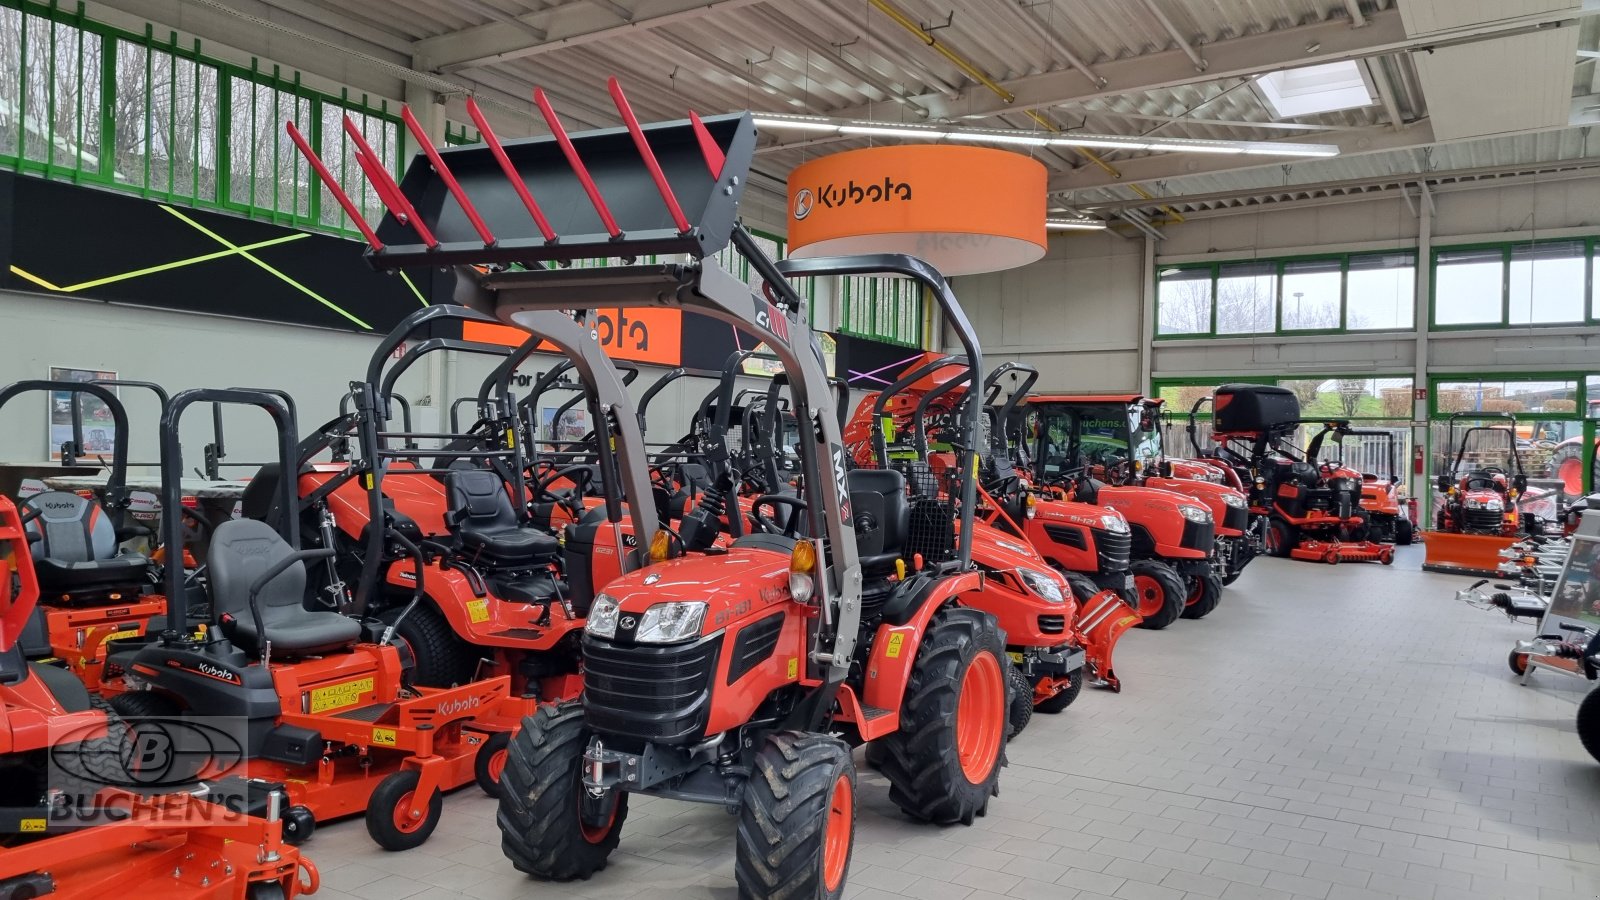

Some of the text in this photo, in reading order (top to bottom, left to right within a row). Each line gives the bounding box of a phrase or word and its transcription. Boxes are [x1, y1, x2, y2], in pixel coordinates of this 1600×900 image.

[817, 177, 912, 208] Kubota
[599, 304, 649, 352] ota
[832, 449, 849, 505] MX
[45, 502, 75, 510] Kubota
[199, 662, 233, 680] Kubota
[438, 695, 480, 716] Kubota
